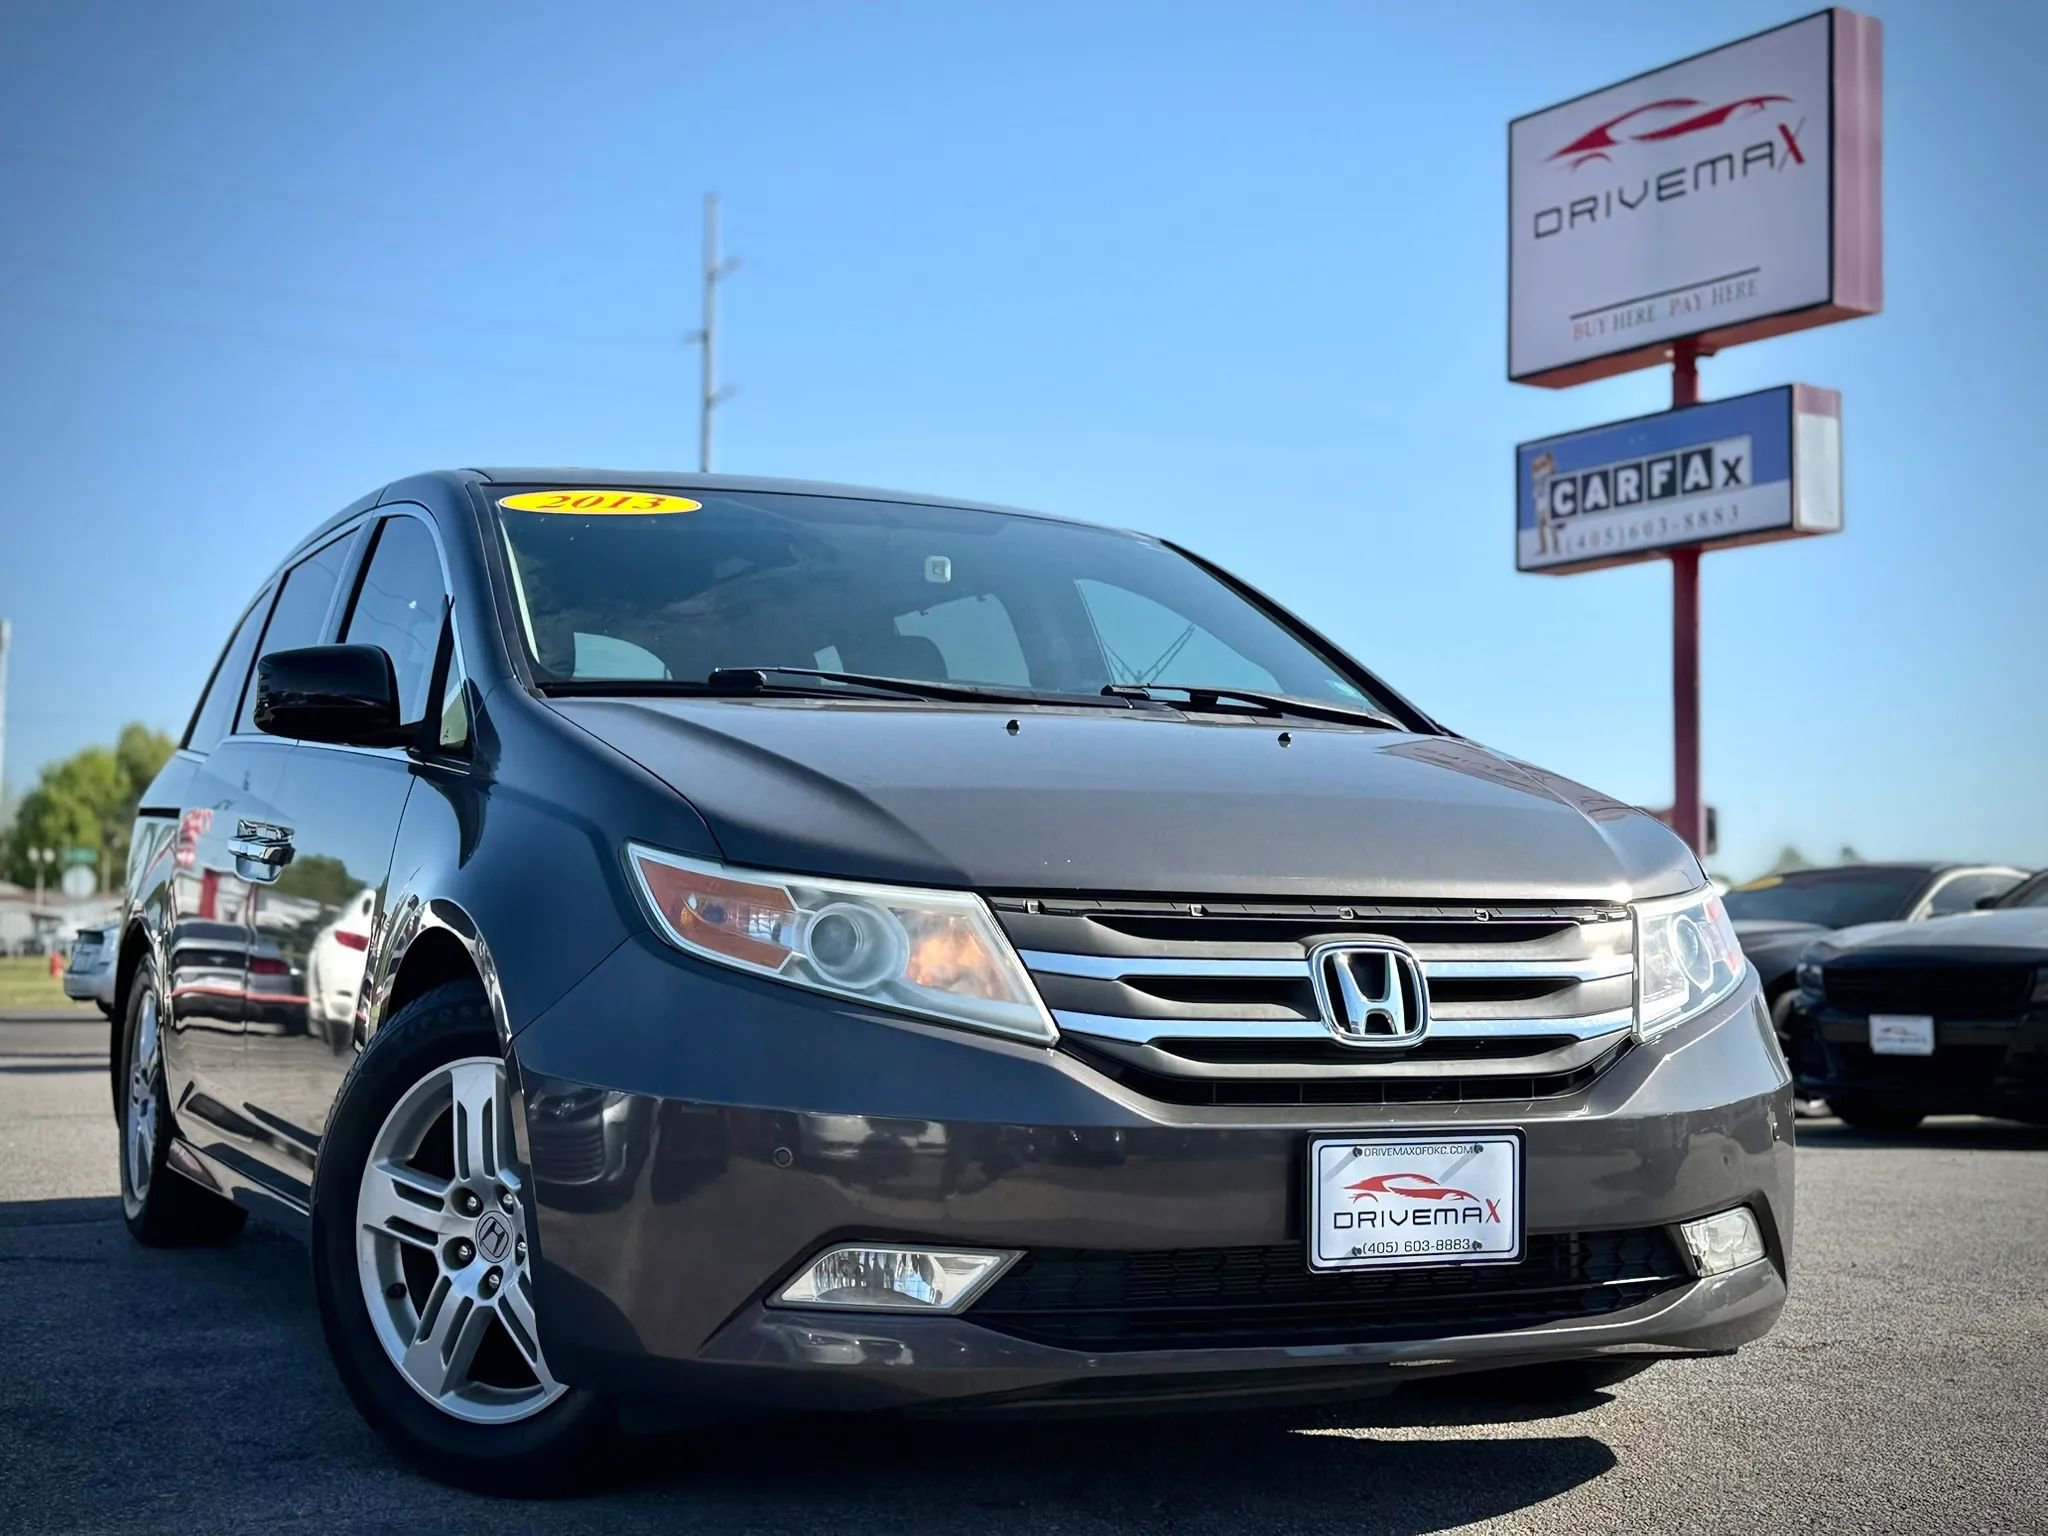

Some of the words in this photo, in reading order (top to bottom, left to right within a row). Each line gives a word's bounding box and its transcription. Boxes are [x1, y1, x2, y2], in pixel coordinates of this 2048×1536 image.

[1534, 117, 1805, 239] DRIVEMAX
[1573, 317, 1607, 341] BUY
[1612, 303, 1656, 332] HERE
[1669, 291, 1704, 317] PAY
[1711, 278, 1757, 307] HERE
[1552, 450, 1745, 517] CARFAX
[536, 495, 666, 509] 2013
[1363, 1145, 1474, 1157] DRIVEMAXOFOKC.COM
[1333, 1199, 1501, 1230] DRIVEMAX
[1362, 1240, 1399, 1255] (405)
[1404, 1238, 1470, 1252] 603-8883
